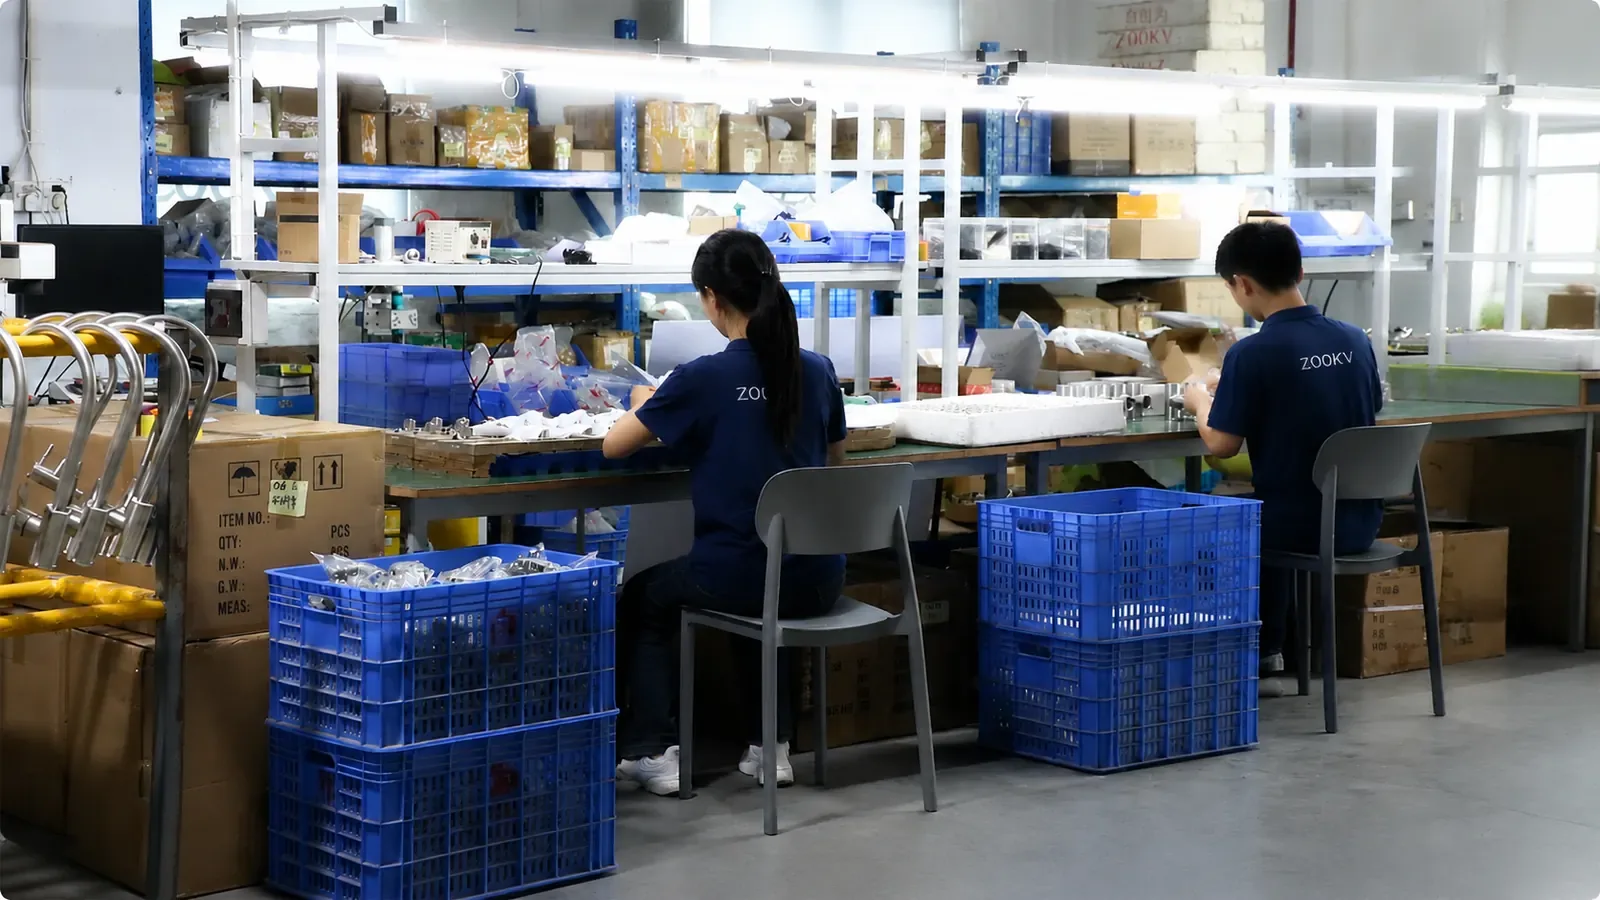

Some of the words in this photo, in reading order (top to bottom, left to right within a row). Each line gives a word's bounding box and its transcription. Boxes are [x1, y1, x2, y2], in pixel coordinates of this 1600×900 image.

[1114, 27, 1173, 49] ZOOKV
[1300, 351, 1353, 370] ZOOKV
[218, 512, 244, 528] ITEM
[247, 511, 270, 525] NO.:
[330, 523, 350, 539] PCS
[218, 535, 242, 550] QTY:
[218, 556, 245, 571] N.W.:
[217, 579, 245, 594] G.W.:
[217, 599, 250, 616] MEAS:
